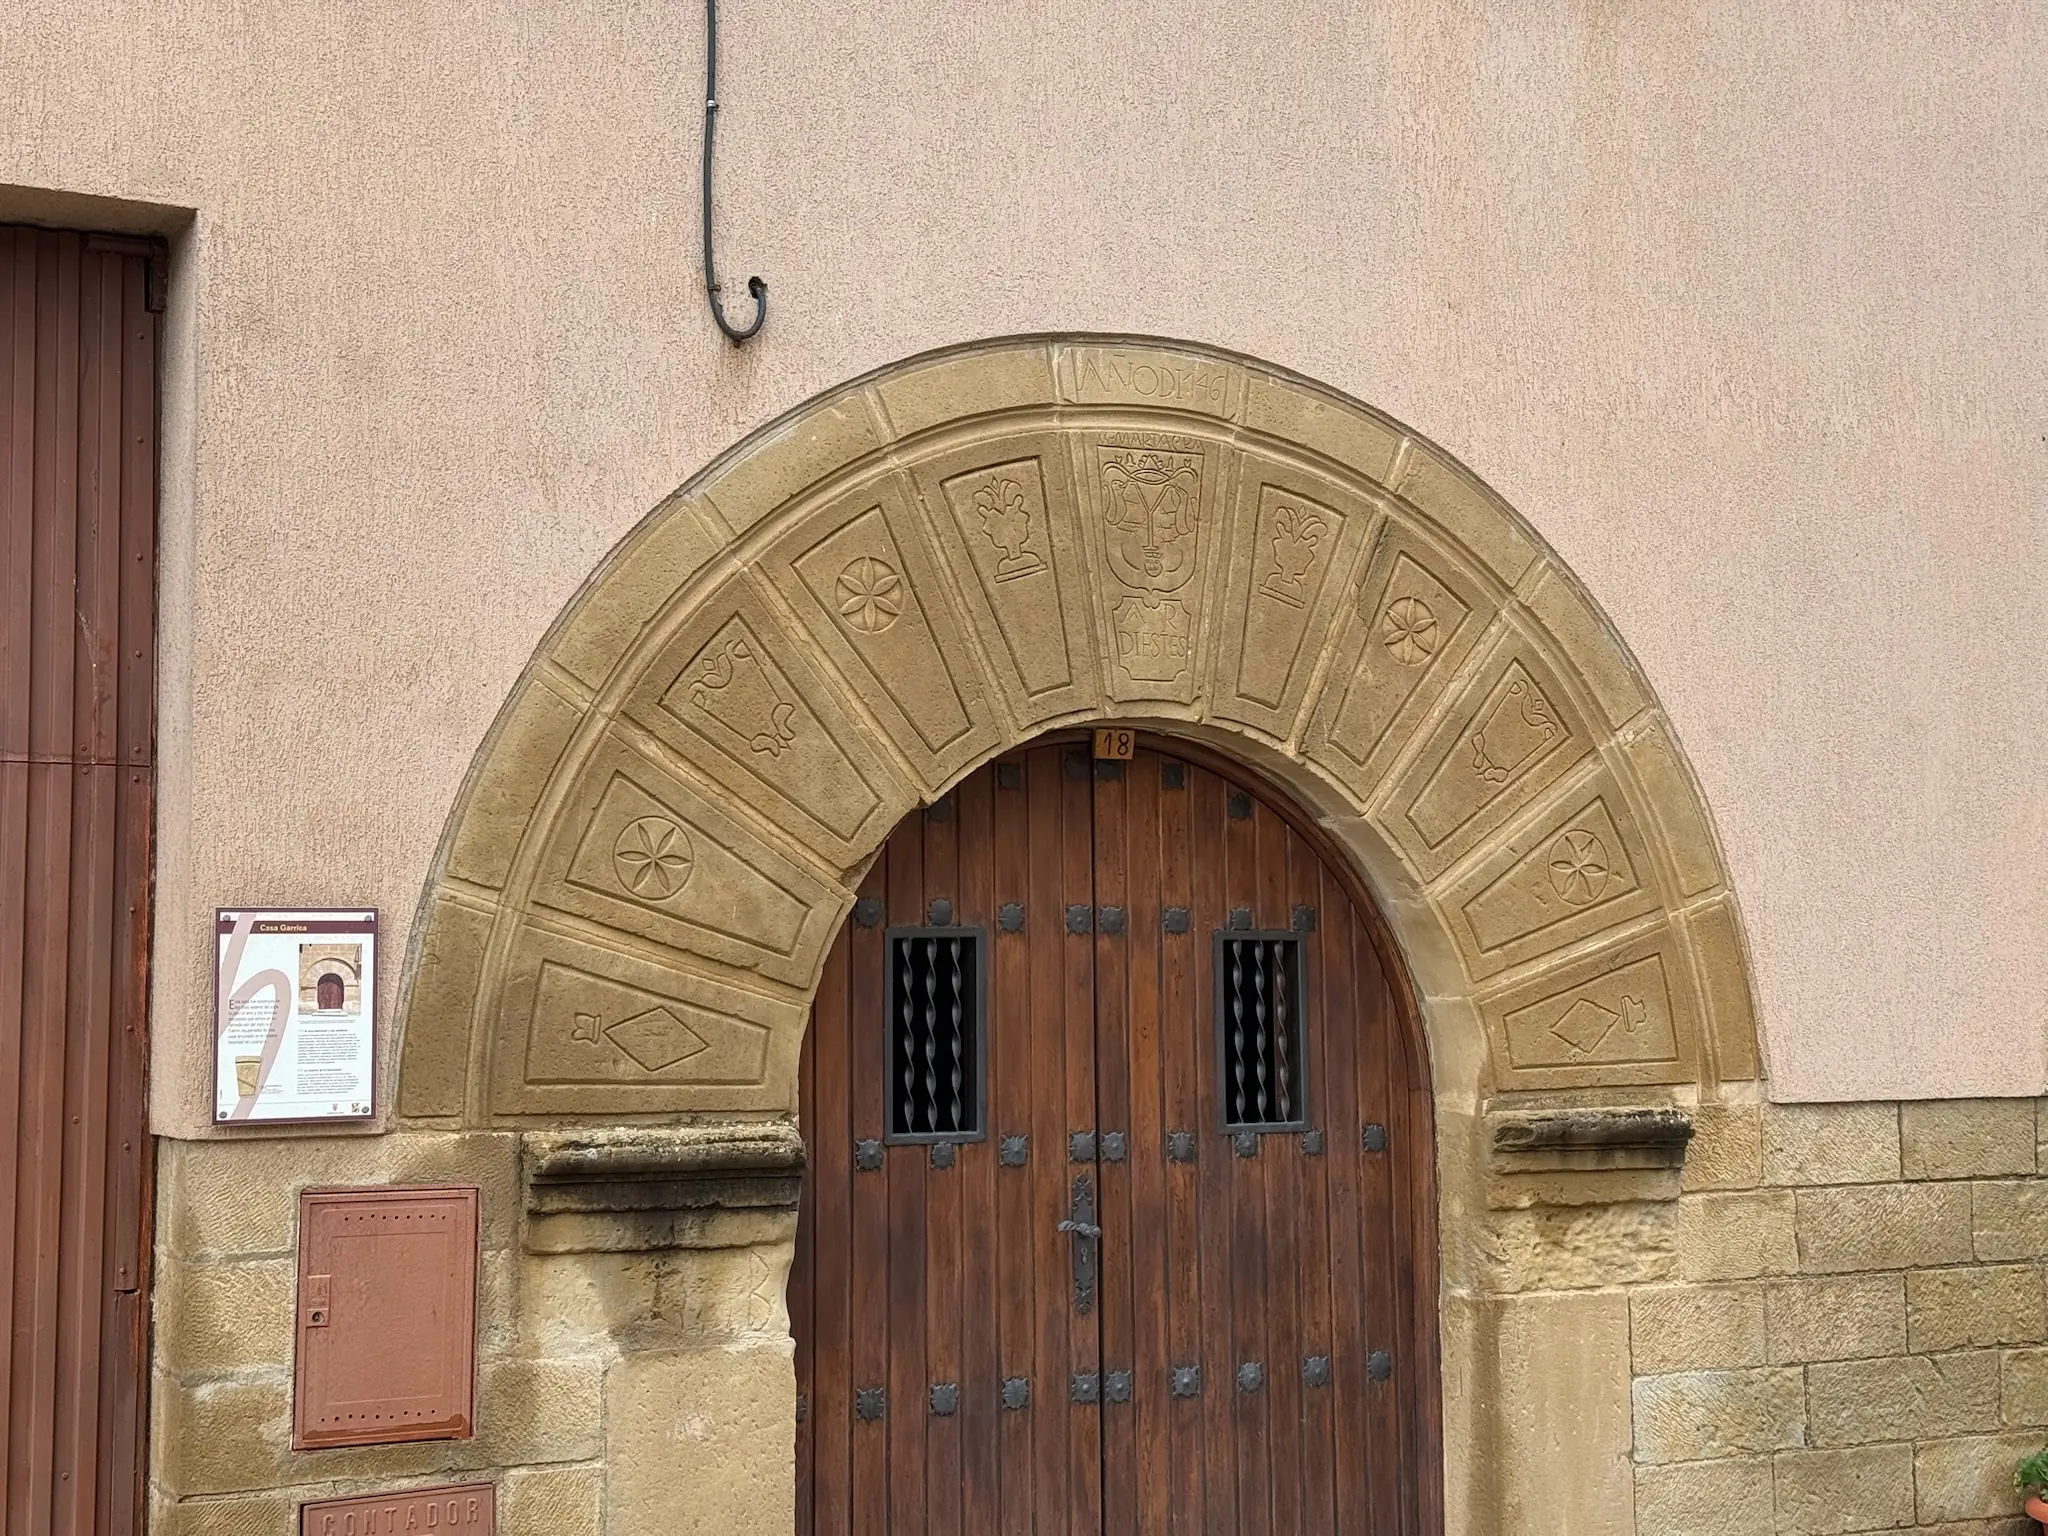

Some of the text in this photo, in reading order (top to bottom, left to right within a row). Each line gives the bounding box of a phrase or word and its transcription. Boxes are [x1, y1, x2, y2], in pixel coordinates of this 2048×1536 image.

[1104, 731, 1129, 757] 18
[259, 923, 307, 932] Casa Garrica
[322, 1497, 479, 1536] CONTADOR
